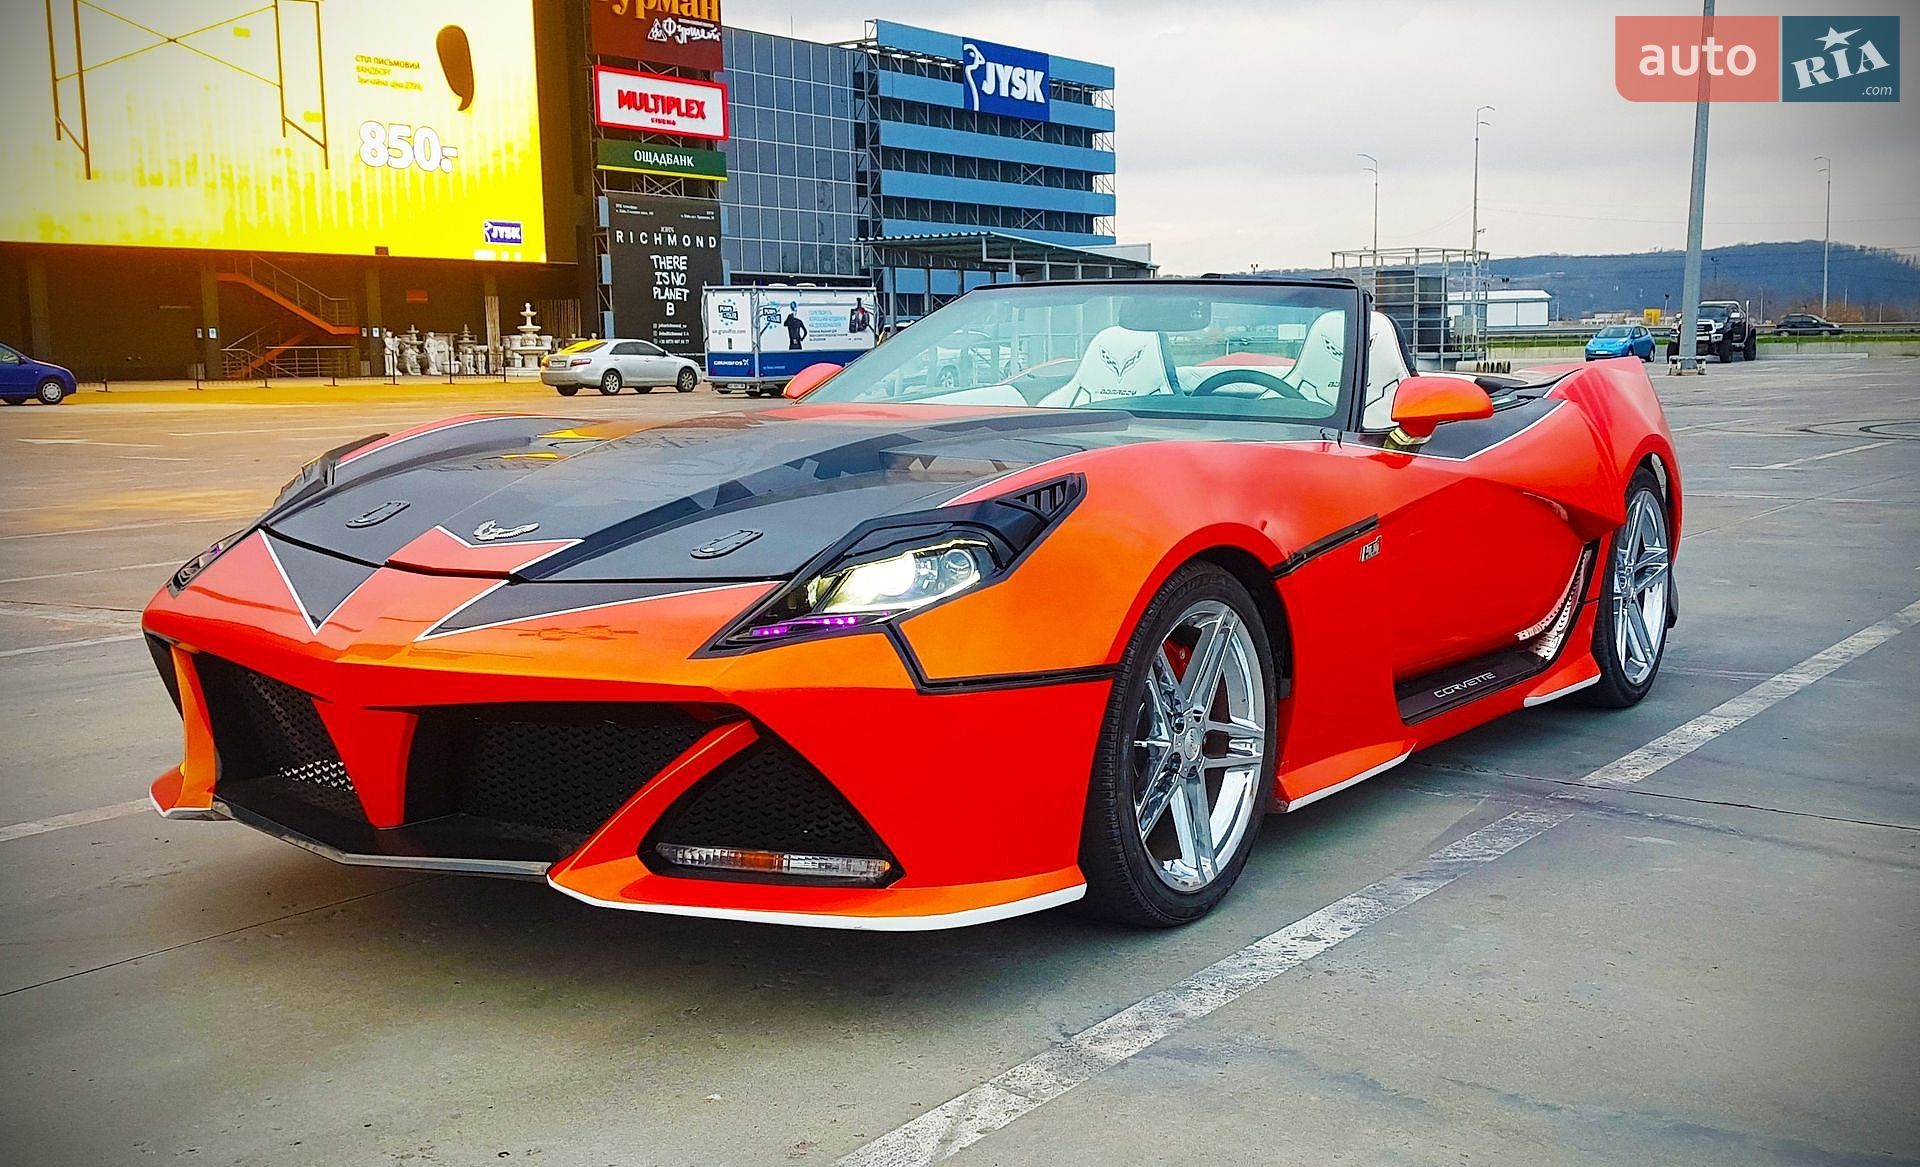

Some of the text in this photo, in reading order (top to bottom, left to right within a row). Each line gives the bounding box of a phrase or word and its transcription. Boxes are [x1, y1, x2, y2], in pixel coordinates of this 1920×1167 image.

[982, 61, 1045, 103] JYSK
[617, 89, 706, 119] MULTIPLEX
[634, 150, 695, 167] ОЩАДБАНК
[491, 225, 521, 240] JYSK
[616, 230, 717, 249] RICHMOND
[650, 254, 688, 271] THERE
[655, 271, 687, 286] IS NO
[652, 286, 690, 302] PLANET
[666, 302, 675, 316] B
[1433, 671, 1497, 698] CORVETTE
